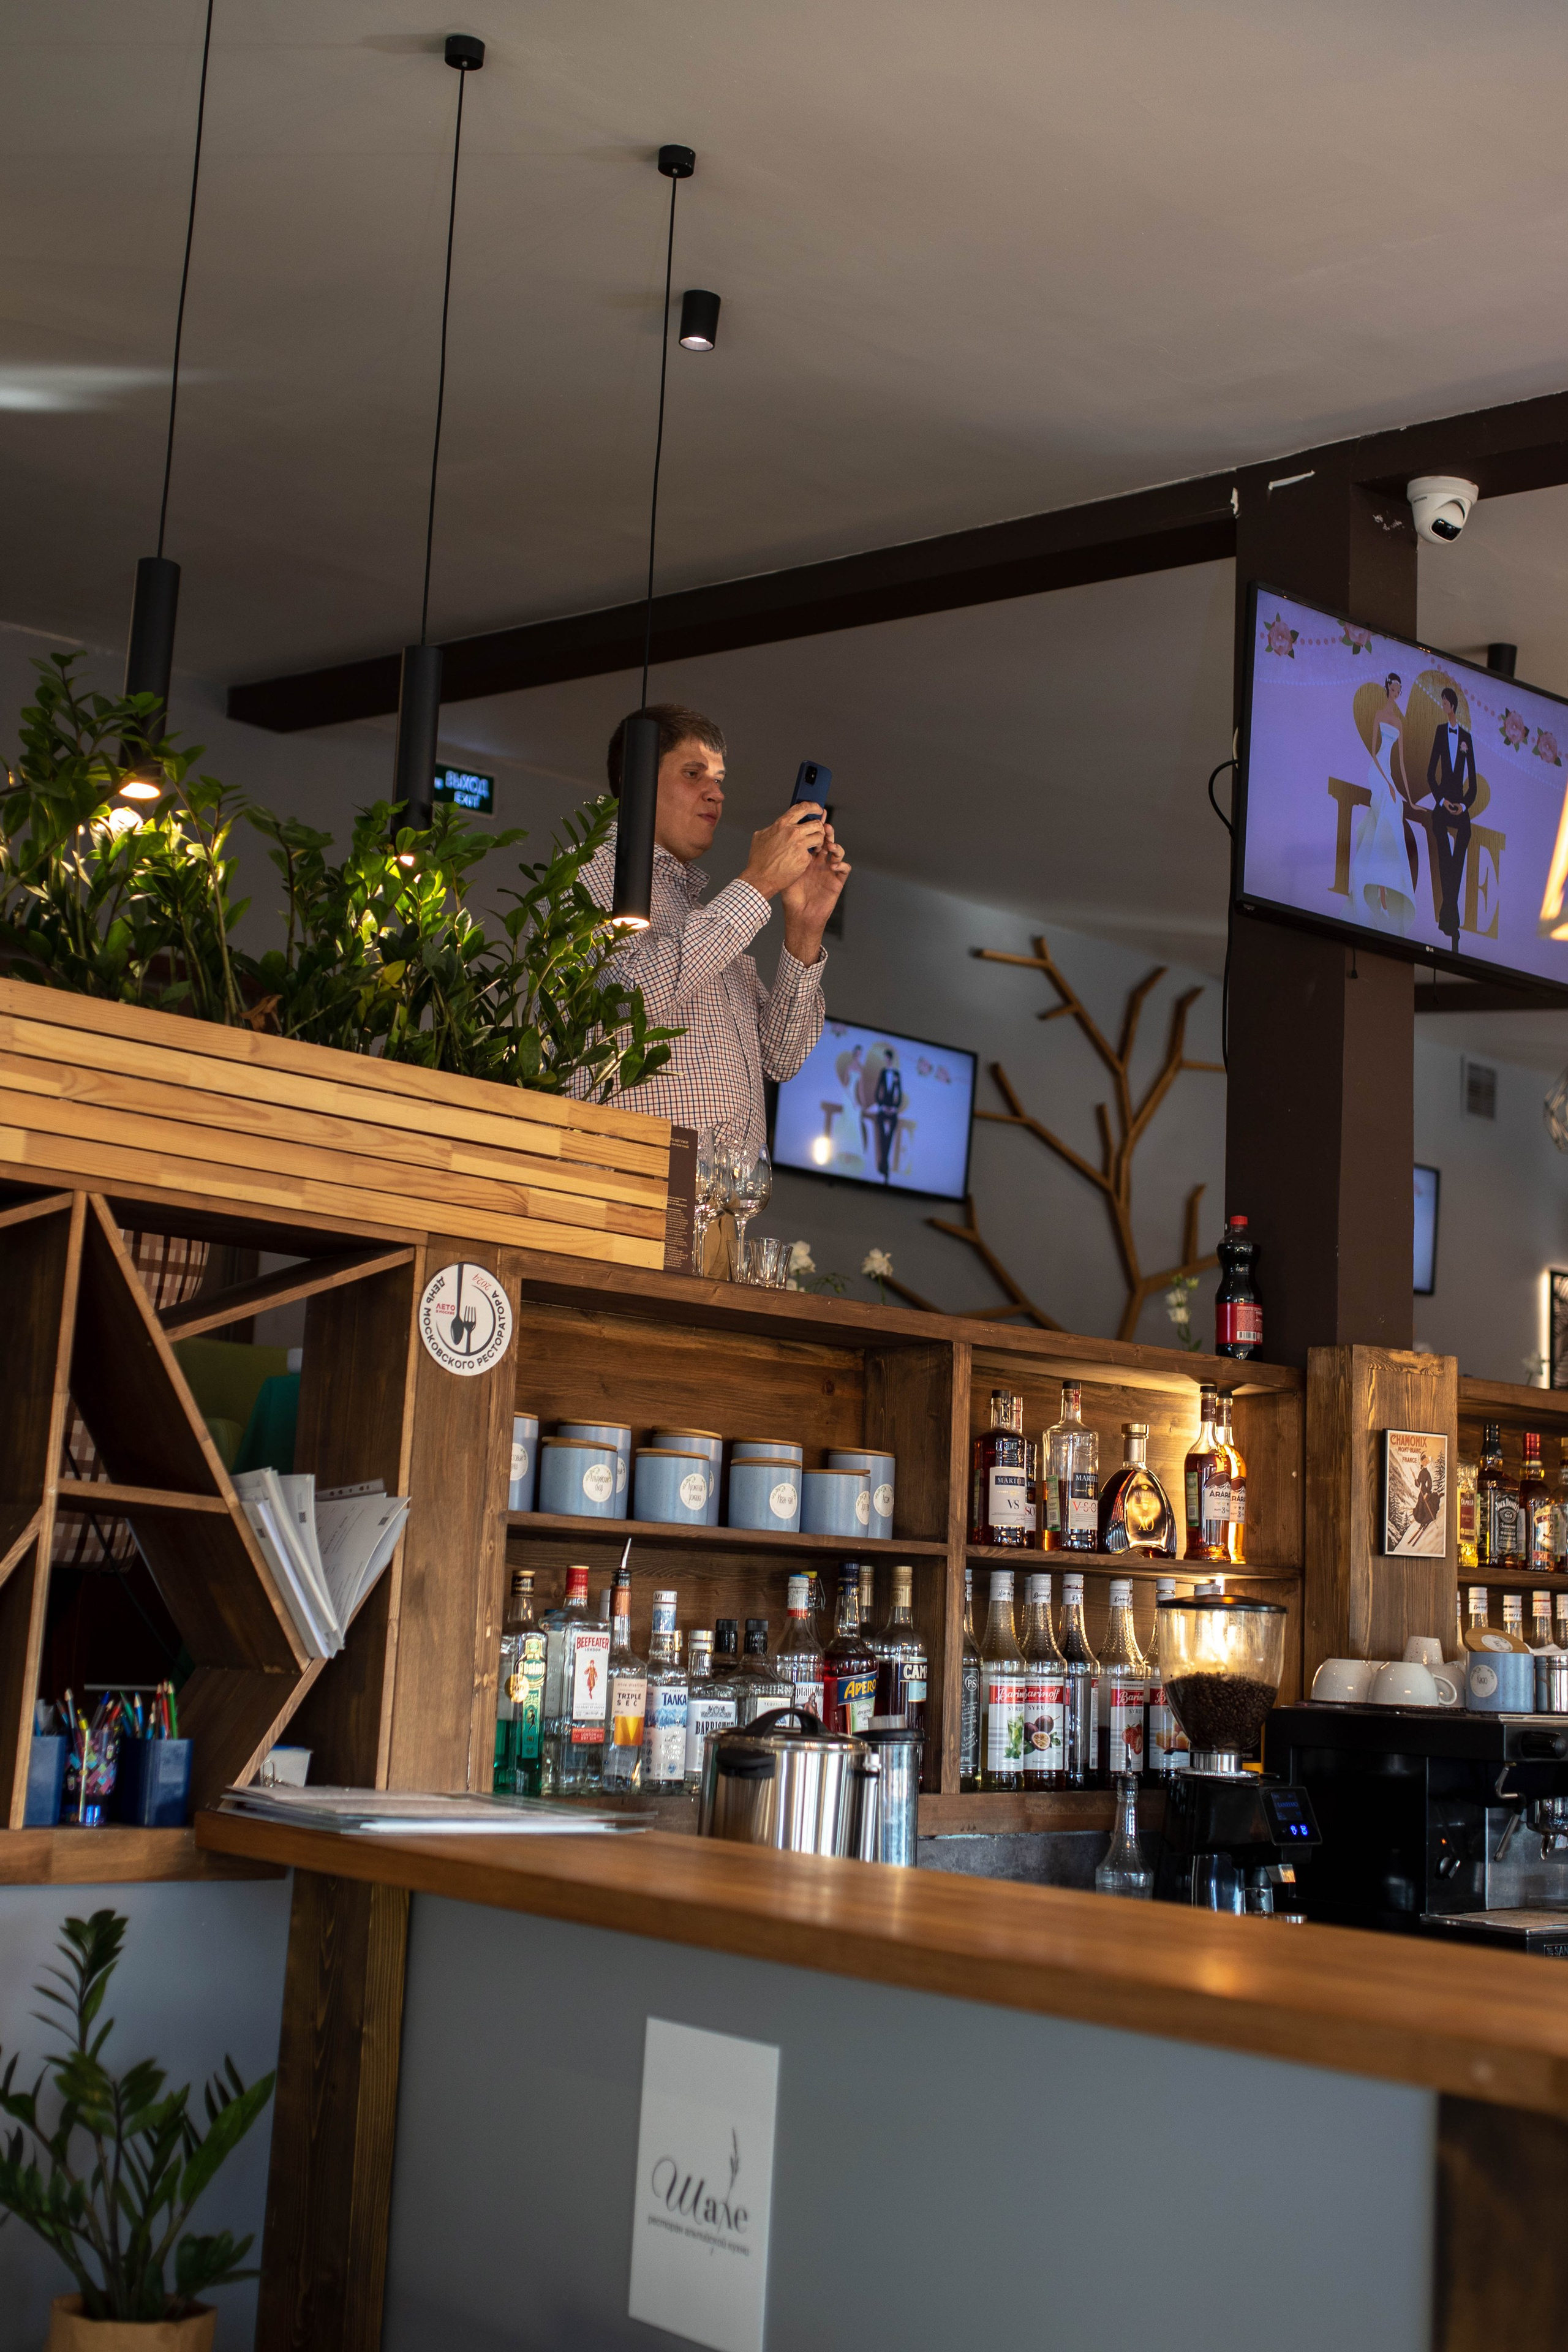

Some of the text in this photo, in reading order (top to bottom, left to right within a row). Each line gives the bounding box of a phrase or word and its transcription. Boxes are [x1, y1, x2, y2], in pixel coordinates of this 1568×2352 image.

[445, 771, 489, 799] ВЫХОД
[454, 790, 482, 809] EXIT
[472, 1273, 491, 1291] 2024
[435, 1303, 456, 1311] ЛЕТО
[423, 1276, 506, 1370] ДЕНЬ МОСКОВСКОГО РЕСТОРАТОРА
[1390, 1434, 1427, 1448] CHAMONIX
[1007, 1499, 1020, 1510] VS
[1137, 1515, 1155, 1531] XO
[576, 1636, 609, 1651] BEEFEATER
[903, 1664, 927, 1680] CAMP
[796, 1685, 814, 1698] ptain
[844, 1679, 876, 1699] APERO
[995, 1687, 1025, 1702] Barin
[1117, 1690, 1144, 1704] Barin
[662, 1692, 687, 1706] ТАЛКА
[652, 2155, 748, 2234] Шале
[647, 2214, 750, 2257] ресторан альпийской кухни
